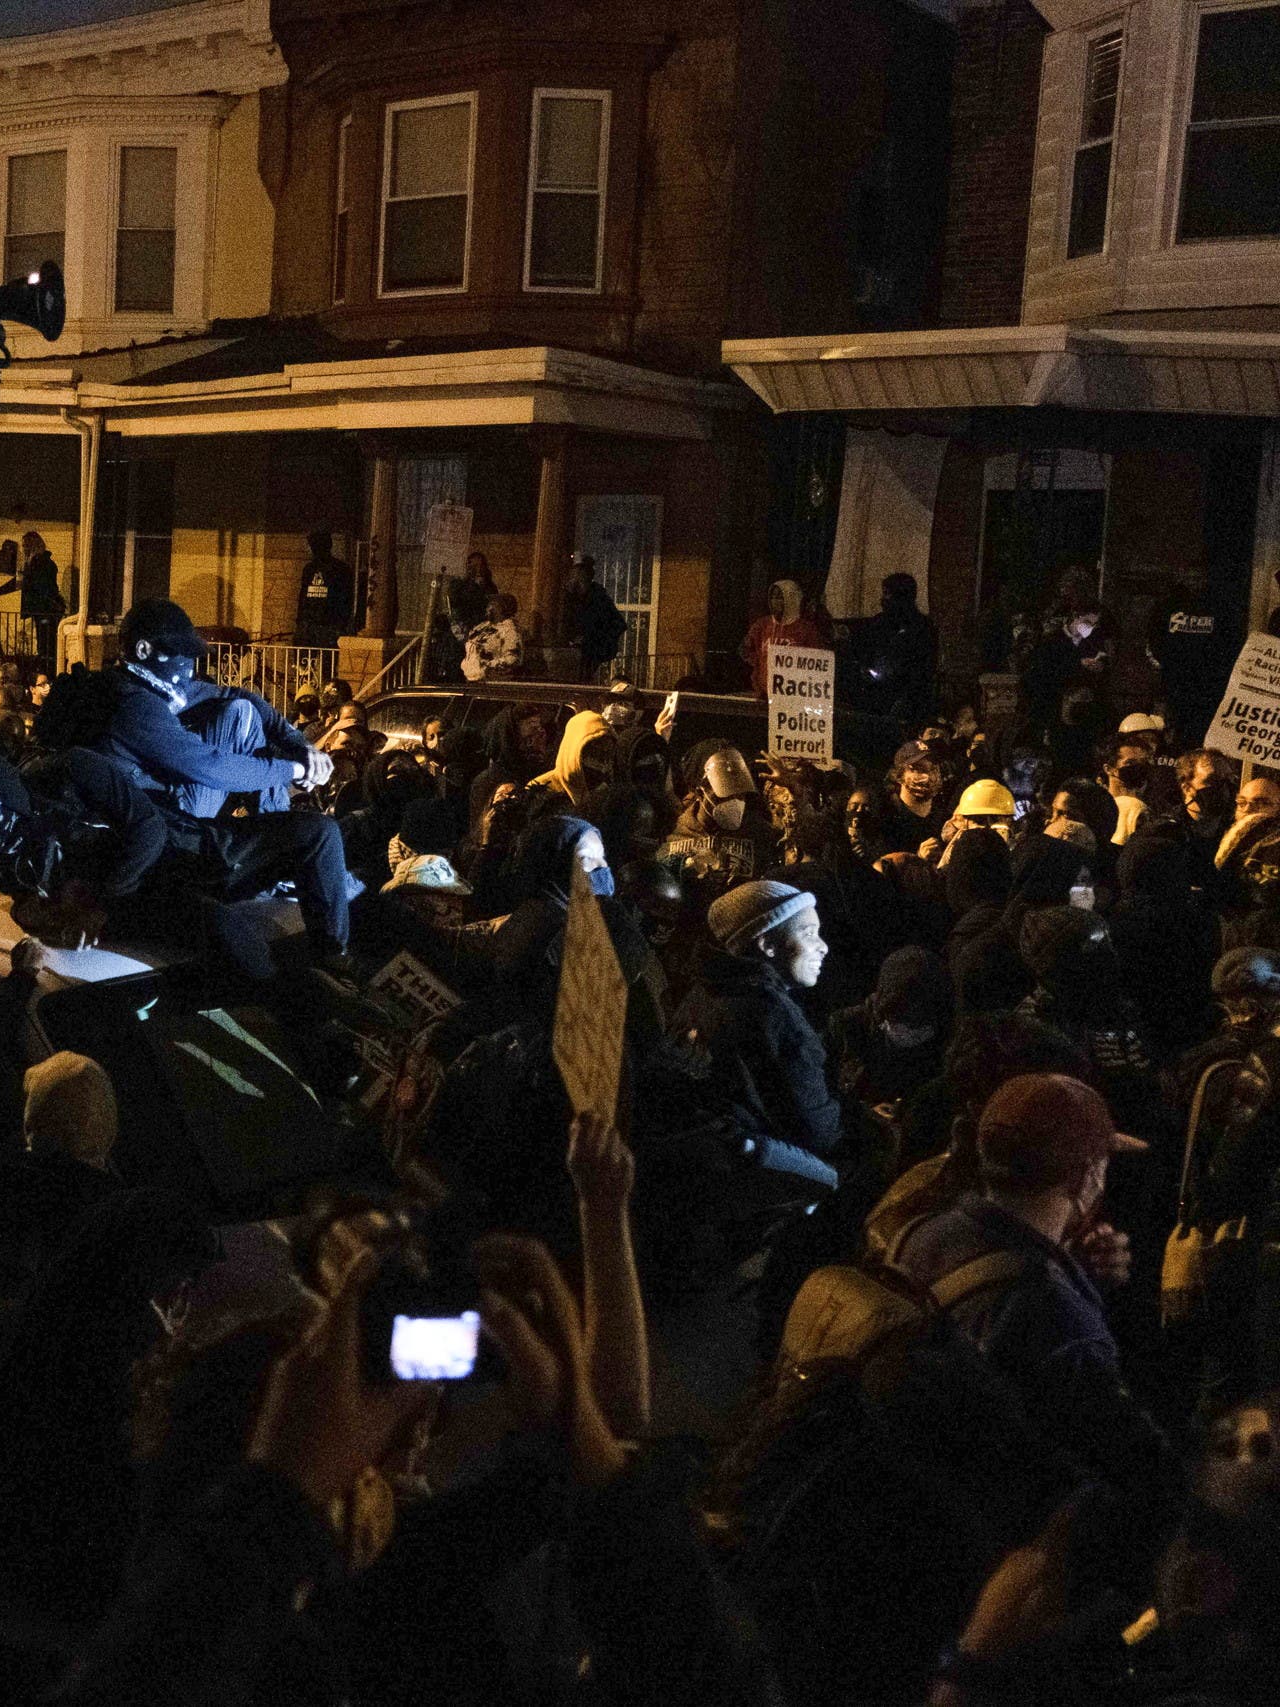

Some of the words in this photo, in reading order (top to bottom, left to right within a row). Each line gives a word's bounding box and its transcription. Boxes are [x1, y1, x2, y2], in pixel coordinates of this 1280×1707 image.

[775, 655, 793, 668] NO
[797, 656, 829, 672] MORE
[773, 674, 831, 699] Racist
[777, 712, 826, 734] Police
[775, 735, 825, 754] Terror!
[397, 961, 453, 1012] THIS
